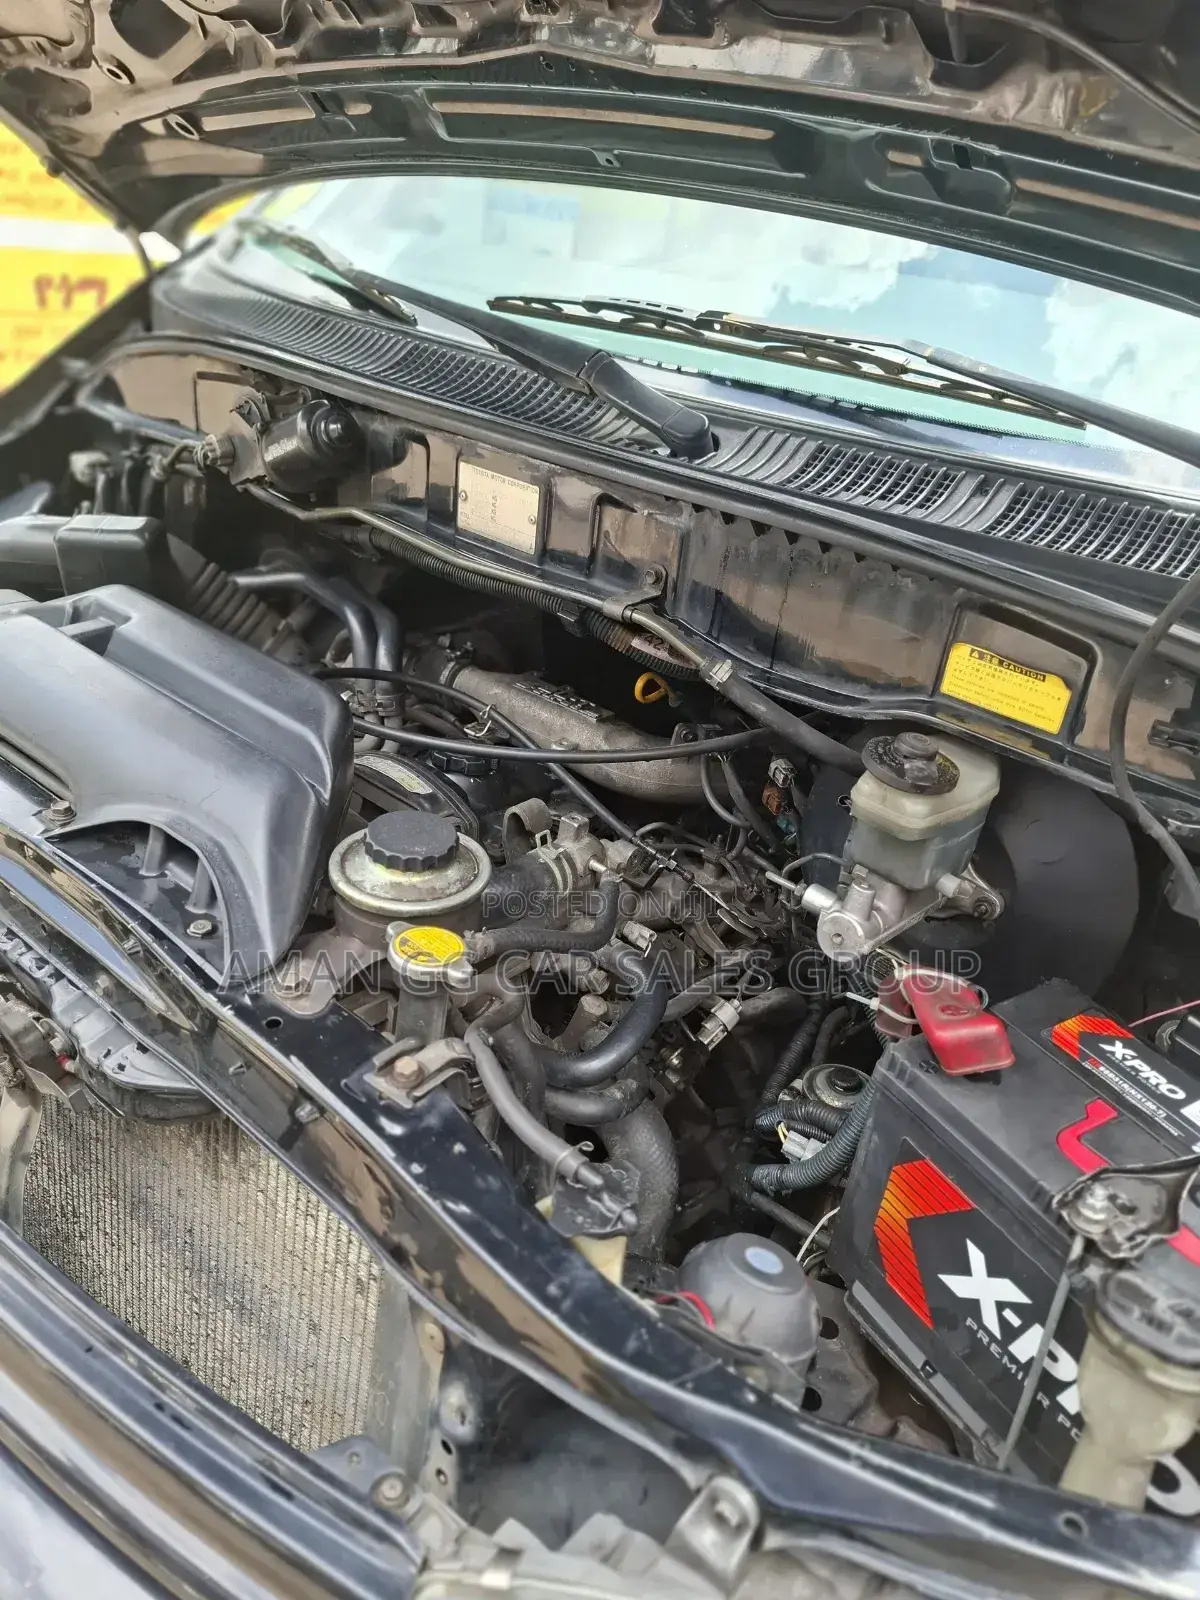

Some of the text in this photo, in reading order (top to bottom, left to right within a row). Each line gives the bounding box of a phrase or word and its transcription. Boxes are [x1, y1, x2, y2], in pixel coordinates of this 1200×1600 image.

[1002, 661, 1044, 682] CAUTION
[1098, 1040, 1187, 1100] X-PRO
[965, 1317, 1051, 1411] PREMIR
